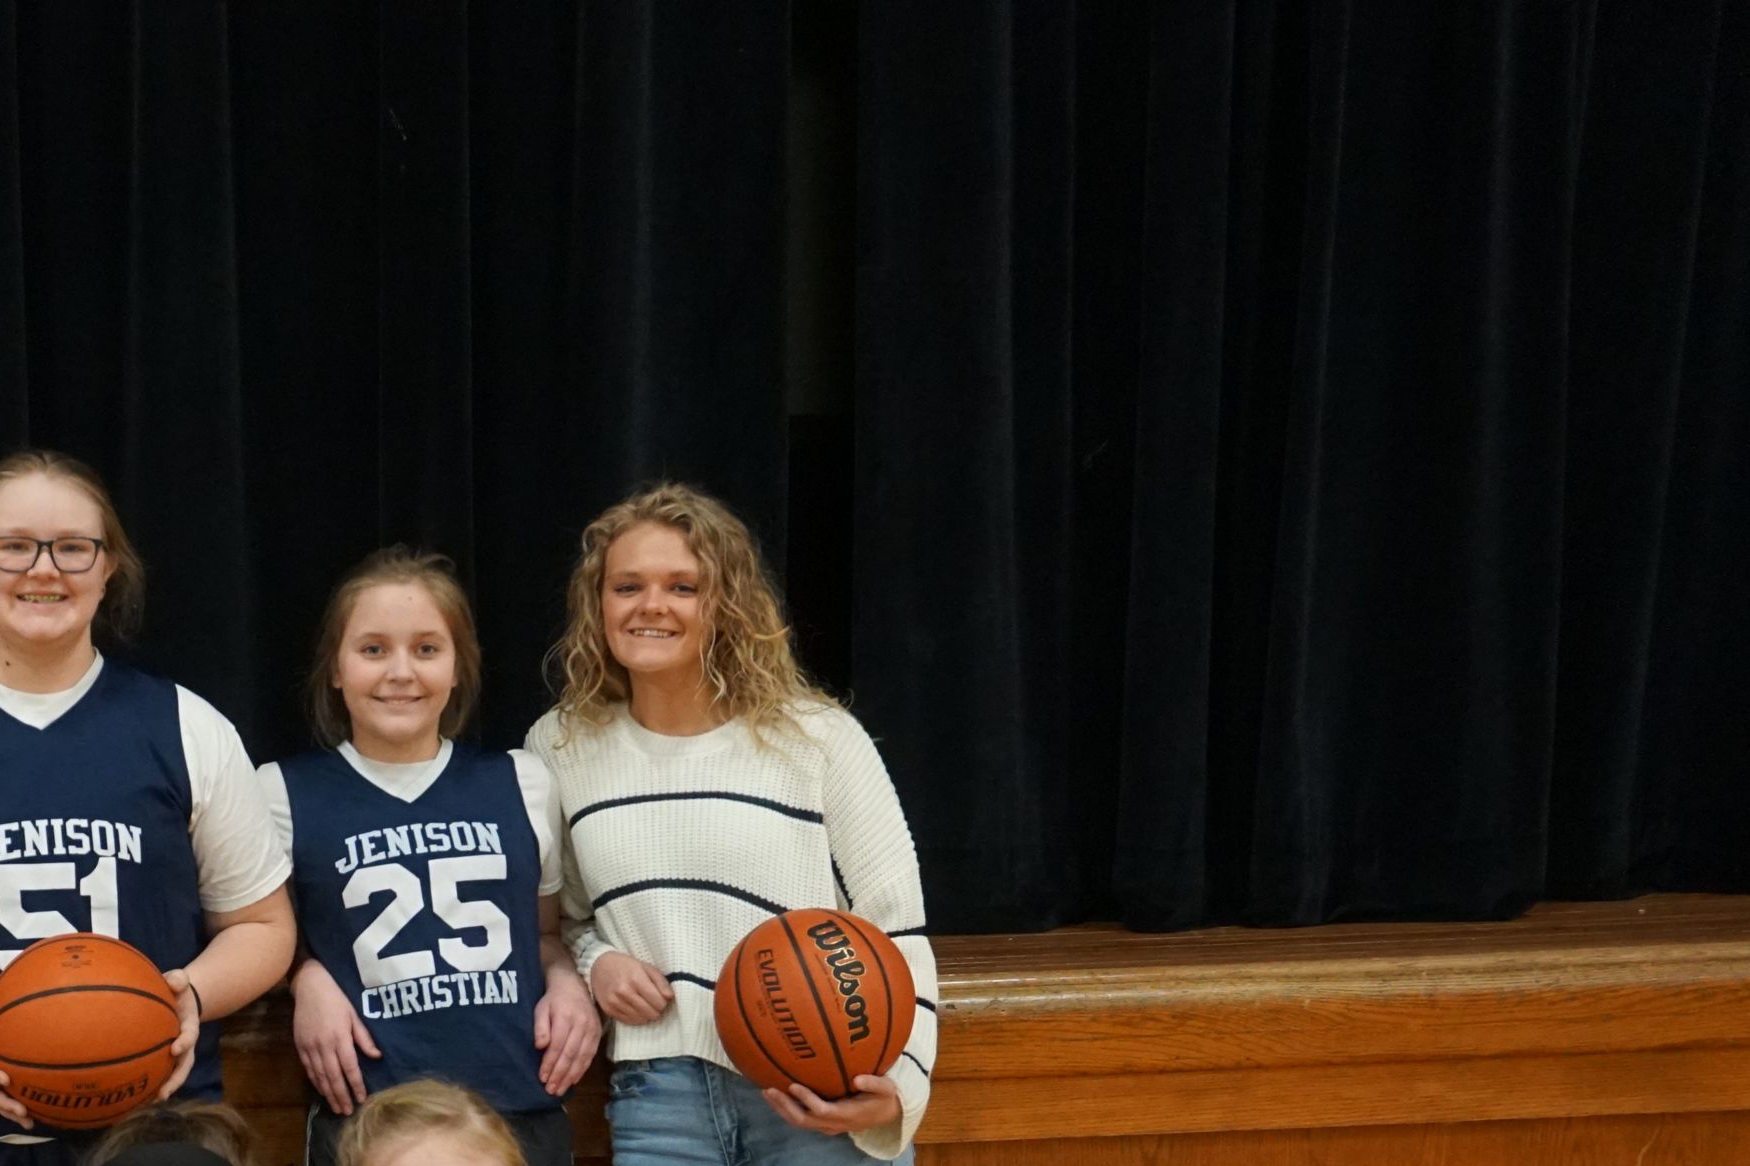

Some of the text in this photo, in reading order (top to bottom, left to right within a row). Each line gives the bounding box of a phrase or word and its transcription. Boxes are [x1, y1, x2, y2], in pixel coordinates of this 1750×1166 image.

[334, 821, 503, 874] JENISON
[342, 854, 512, 988] 25
[361, 970, 518, 1019] CHRISTIAN
[757, 948, 817, 1060] EVOLUTION
[807, 919, 872, 1046] Wilson
